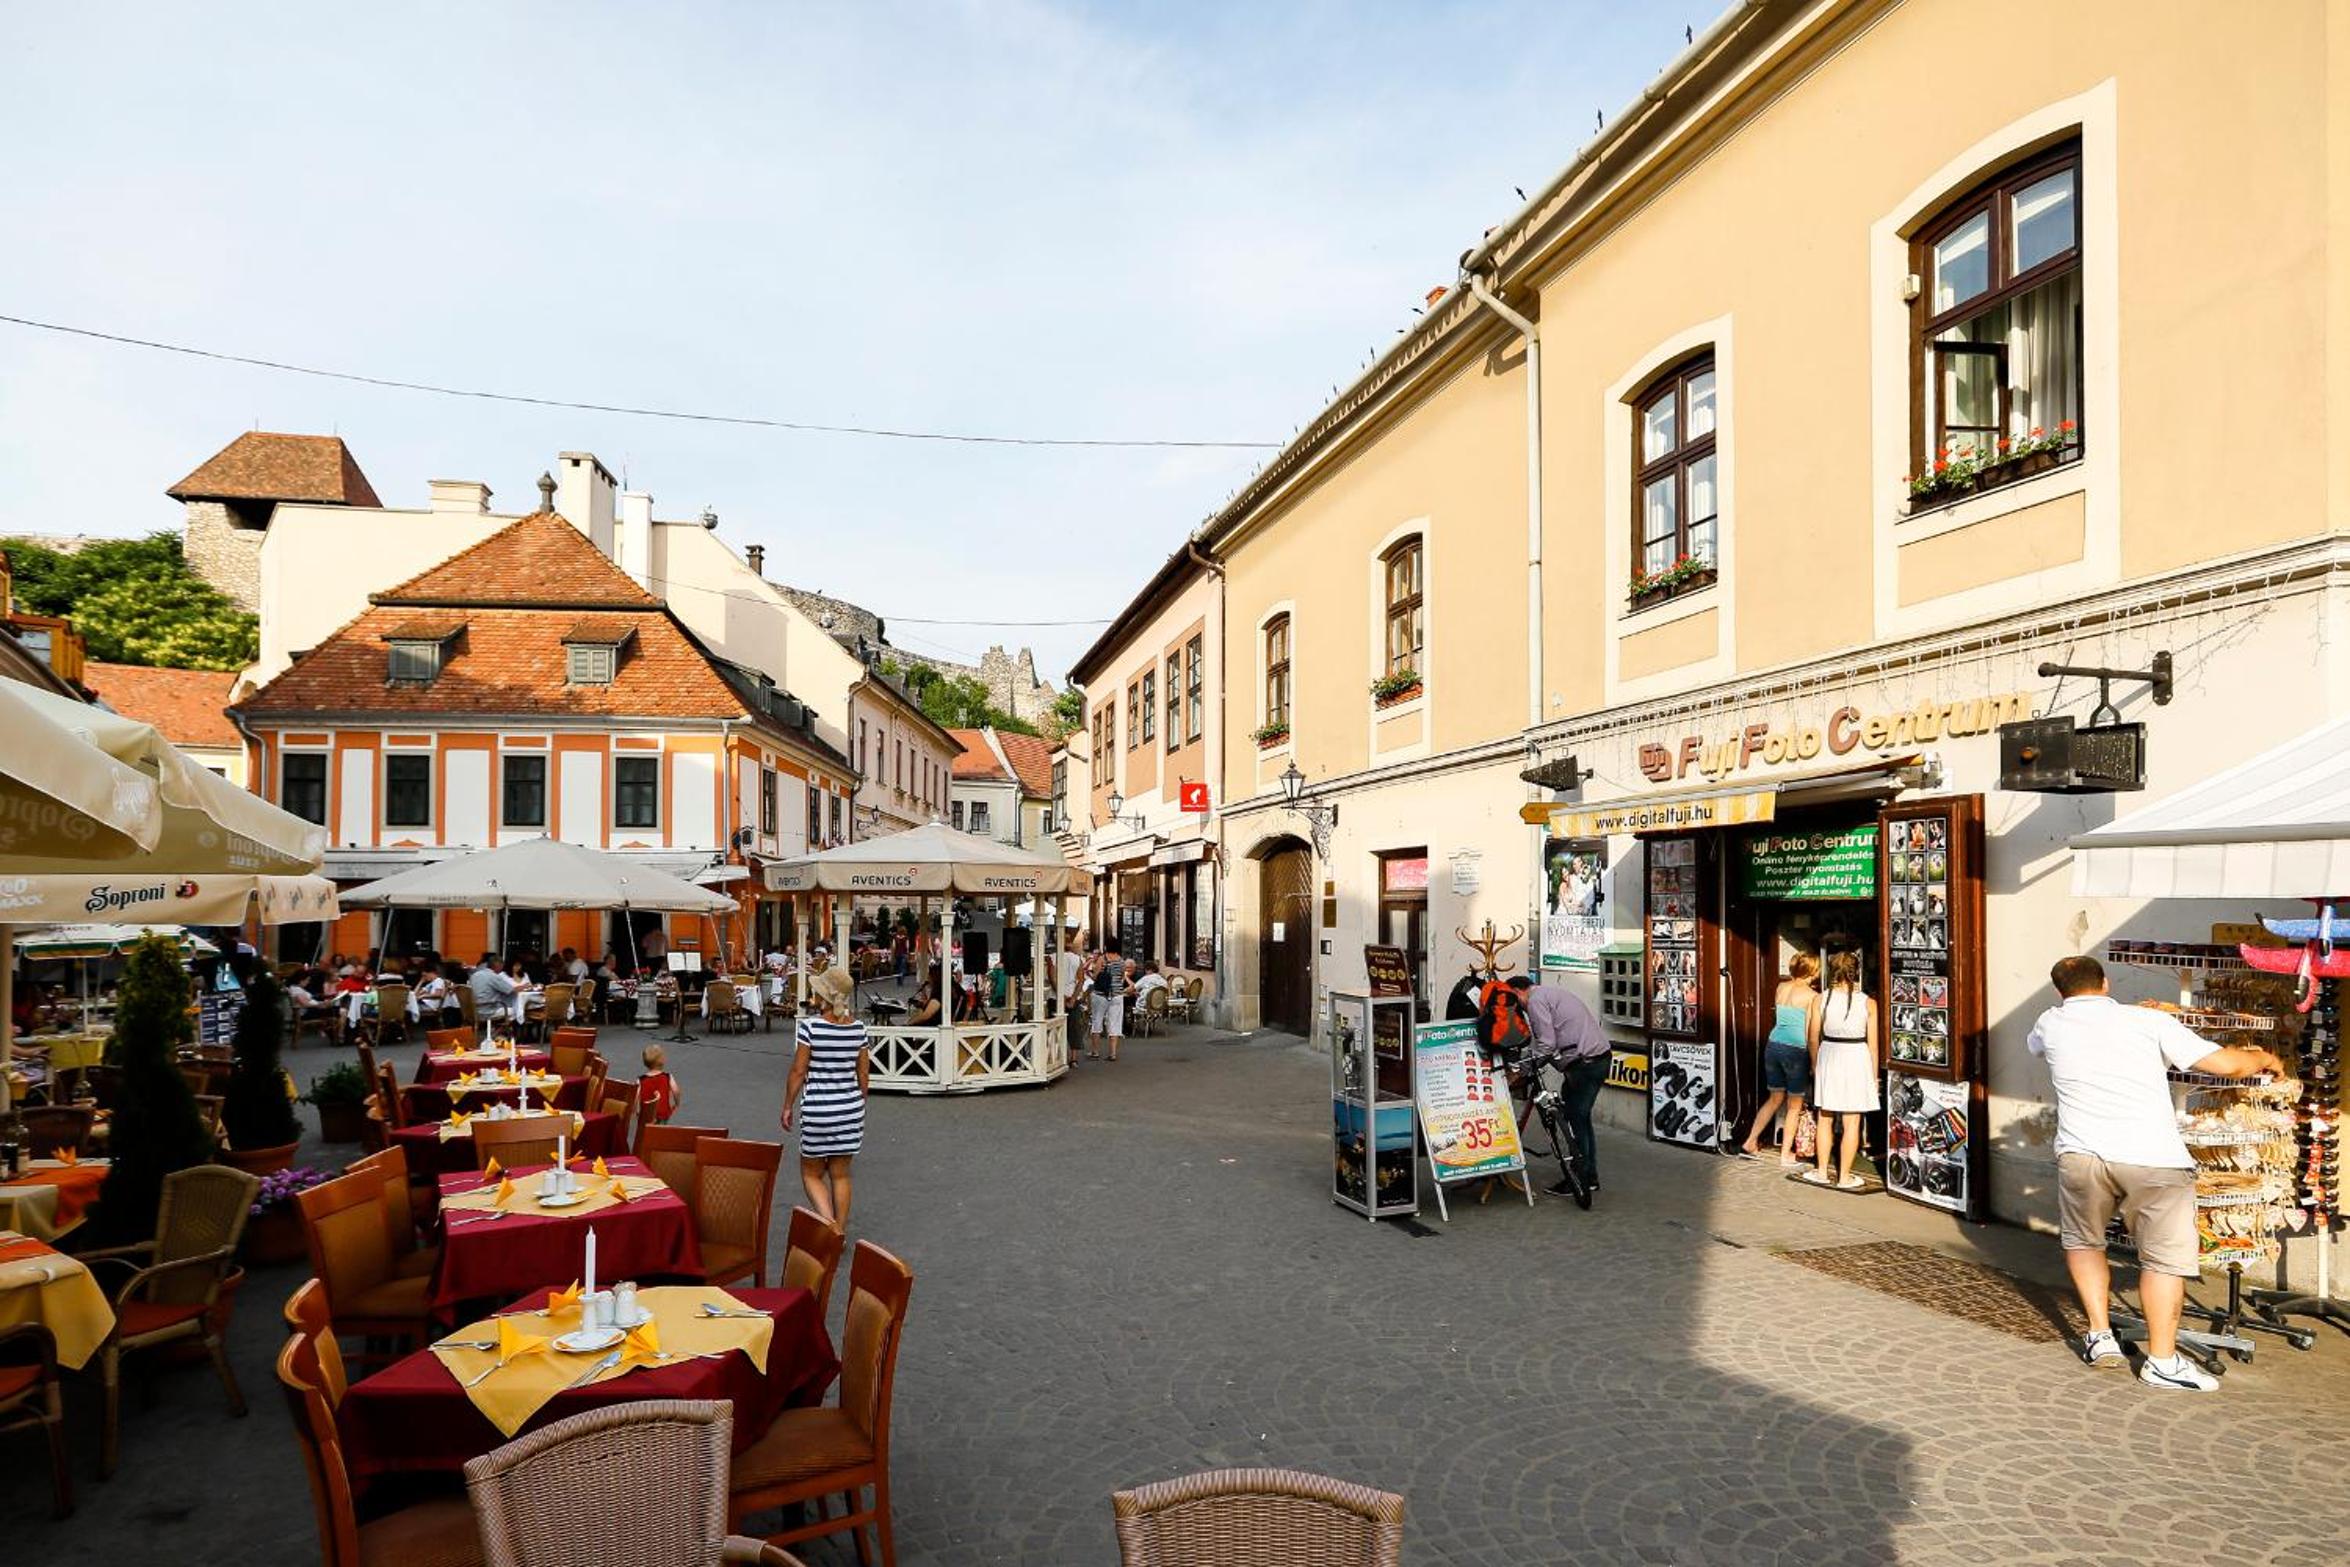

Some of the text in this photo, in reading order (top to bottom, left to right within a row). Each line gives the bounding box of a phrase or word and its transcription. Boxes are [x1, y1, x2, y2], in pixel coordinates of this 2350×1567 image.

[1828, 691, 2033, 756] Centrum
[1595, 805, 1712, 830] www.digitalfuji.hu
[1765, 866, 1802, 875] Poszter
[851, 875, 911, 886] AVENTICS
[984, 878, 1037, 888] AVENTICS
[1755, 875, 1875, 889] www.digitalfuji.hu
[85, 883, 165, 913] Soproni
[1461, 1119, 1492, 1150] 35
